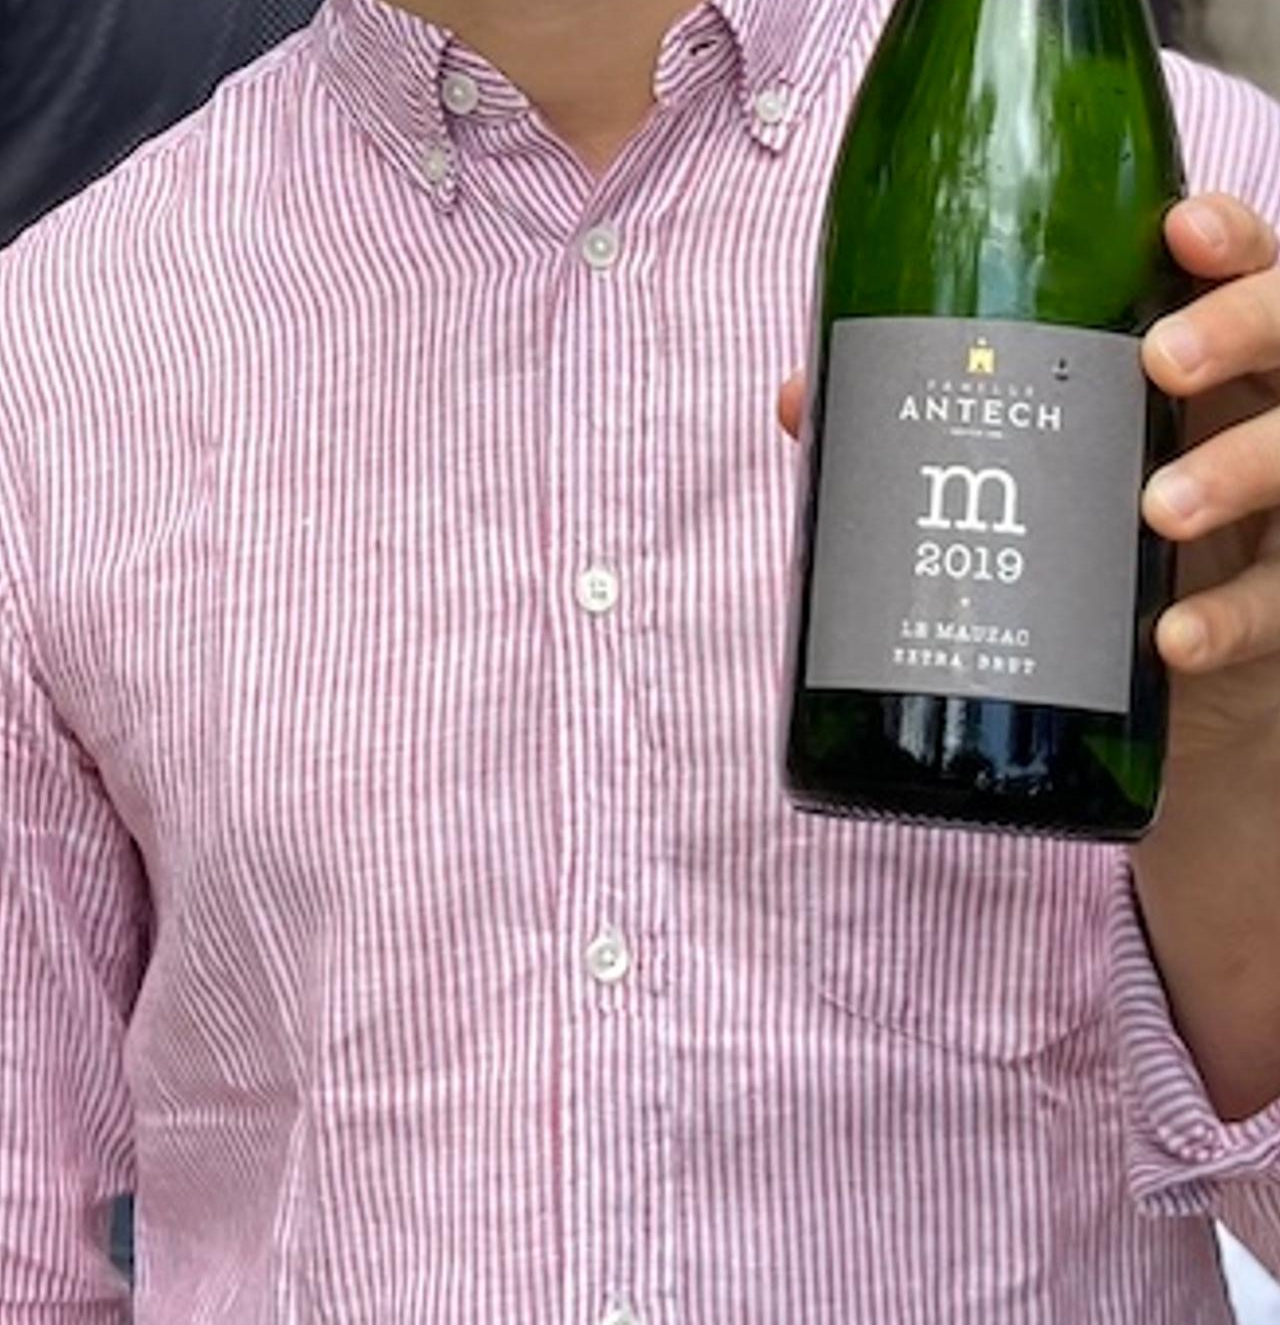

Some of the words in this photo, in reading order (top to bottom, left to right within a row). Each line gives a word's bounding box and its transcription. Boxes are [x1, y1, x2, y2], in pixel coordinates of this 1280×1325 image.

[898, 394, 1061, 431] ANTECH
[917, 465, 1026, 535] m
[915, 541, 1023, 584] 2019
